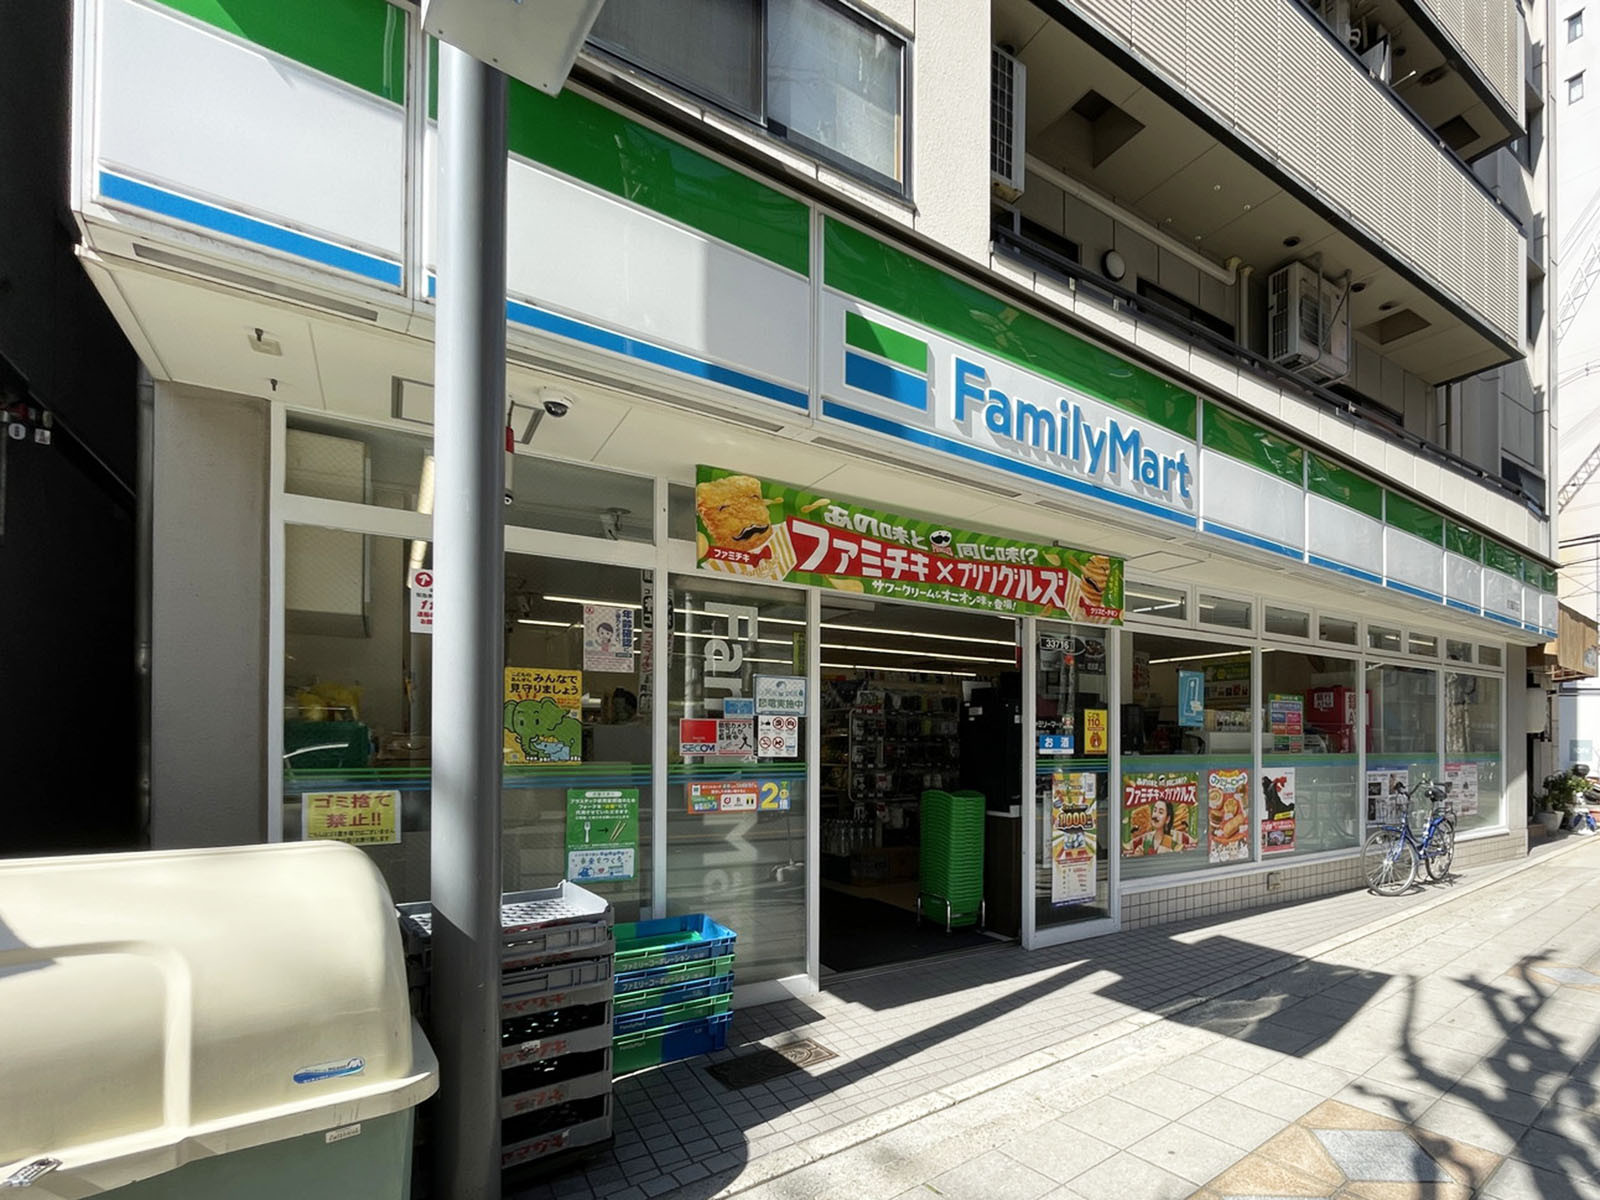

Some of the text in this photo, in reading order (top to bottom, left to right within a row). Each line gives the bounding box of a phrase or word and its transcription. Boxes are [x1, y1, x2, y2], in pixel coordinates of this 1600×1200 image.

[953, 355, 1191, 498] FamilyMart
[824, 505, 928, 549] あの味と
[714, 549, 750, 562] ファミチキ
[533, 673, 578, 685] みんなで
[510, 683, 579, 695] 見守りましょう
[1044, 736, 1070, 748] お酒
[682, 744, 715, 753] SECOM
[314, 794, 392, 809] ゴミ捨て
